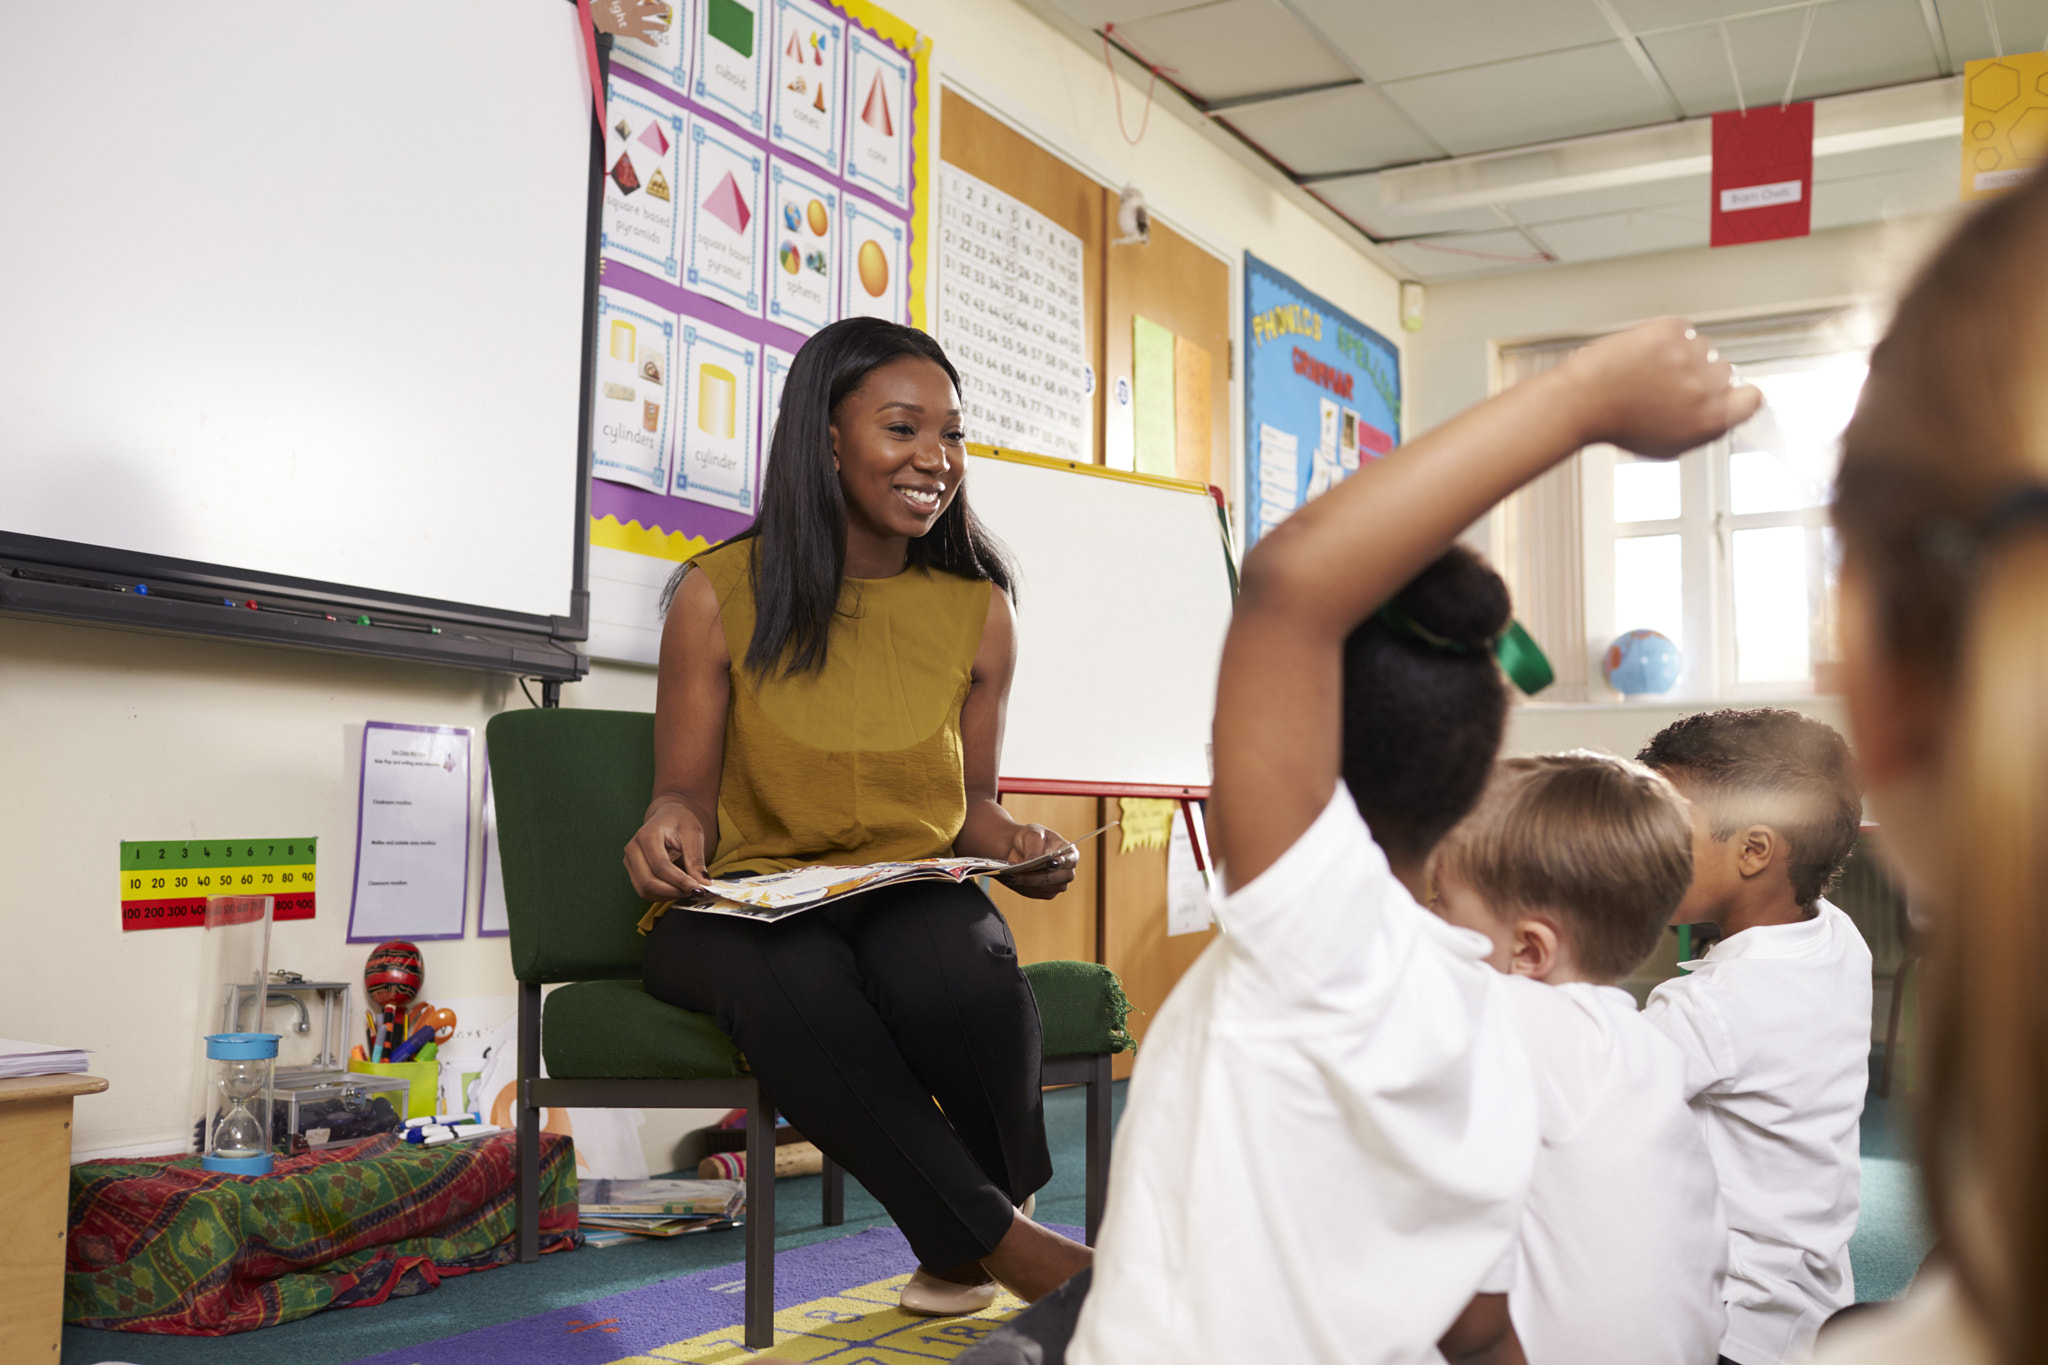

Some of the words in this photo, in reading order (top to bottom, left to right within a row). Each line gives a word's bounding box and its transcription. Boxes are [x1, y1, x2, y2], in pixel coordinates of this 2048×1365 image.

[715, 64, 747, 91] cuboid
[793, 108, 819, 129] cones
[868, 148, 887, 165] cone
[606, 196, 640, 215] square
[643, 205, 670, 229] based
[616, 220, 660, 245] pyramids
[946, 203, 957, 220] 11
[962, 210, 972, 227] 12
[976, 219, 987, 235] 13
[991, 226, 1003, 241] 14
[1006, 231, 1018, 249] 15
[1021, 241, 1032, 256] 16
[1034, 247, 1044, 261] 17
[1067, 269, 1079, 283] 20
[698, 234, 726, 253] square
[729, 244, 751, 265] based
[1068, 246, 1079, 258] 10
[708, 258, 741, 281] pyramid
[944, 228, 956, 245] 21
[960, 236, 972, 253] 22
[974, 244, 986, 260] 23
[989, 251, 1002, 267] 24
[1003, 258, 1017, 274] 25
[1018, 265, 1031, 280] 26
[1033, 271, 1045, 286] 27
[1046, 278, 1056, 294] 28
[1068, 292, 1080, 307] 30
[787, 280, 821, 304] spheres
[944, 254, 955, 271] 31
[960, 261, 971, 279] 32
[974, 268, 986, 285] 33
[1003, 282, 1015, 299] 35
[1018, 288, 1030, 305] 36
[1033, 295, 1045, 310] 37
[1047, 302, 1057, 318] 38
[1070, 316, 1081, 330] 40
[944, 282, 955, 298] 41
[960, 291, 970, 306] 42
[973, 297, 985, 312] 43
[988, 304, 1000, 318] 44
[1002, 311, 1014, 326] 45
[1016, 317, 1029, 332] 46
[1032, 323, 1044, 336] 47
[1046, 329, 1057, 344] 48
[1253, 304, 1322, 347] PHONICS
[944, 308, 955, 324] 51
[959, 315, 970, 332] 52
[973, 322, 984, 338] 53
[987, 329, 999, 344] 54
[1001, 335, 1014, 351] 55
[1016, 341, 1028, 357] 56
[1031, 347, 1043, 360] 57
[1045, 352, 1056, 368] 58
[1059, 358, 1069, 371] 59
[944, 336, 955, 352] 61
[959, 343, 970, 359] 62
[972, 350, 984, 366] 63
[986, 356, 998, 370] 64
[1001, 362, 1013, 378] 65
[1015, 368, 1027, 383] 66
[1030, 373, 1042, 388] 67
[1044, 379, 1056, 393] 68
[1058, 384, 1069, 397] 69
[1292, 346, 1354, 401] GRAMMAR
[960, 370, 970, 387] 72
[973, 376, 984, 393] 73
[986, 382, 998, 397] 74
[1001, 387, 1012, 404] 75
[1015, 393, 1027, 409] 76
[1030, 399, 1042, 413] 77
[1044, 404, 1055, 420] 78
[972, 403, 984, 420] 83
[986, 409, 998, 424] 84
[1000, 414, 1012, 430] 85
[1014, 420, 1026, 434] 86
[1029, 424, 1040, 438] 87
[602, 422, 654, 449] cylinders
[695, 448, 736, 470] cylinder
[136, 849, 140, 860] 1
[158, 848, 165, 859] 2
[181, 848, 188, 859] 3
[203, 846, 210, 857] 4
[226, 846, 232, 857] 5
[247, 846, 253, 857] 6
[268, 846, 274, 856] 7
[288, 845, 294, 856] 8
[307, 845, 314, 855] 9
[130, 878, 141, 889] 10
[151, 878, 165, 889] 20
[175, 877, 188, 888] 30
[197, 876, 210, 886] 40
[219, 875, 232, 886] 50
[241, 874, 253, 885] 60
[262, 873, 274, 884] 70
[282, 872, 294, 883] 80
[302, 872, 314, 882] 90
[123, 908, 141, 919] 100
[144, 906, 164, 919] 200
[167, 905, 187, 917] 300
[190, 905, 209, 916] 400
[276, 900, 293, 911] 800
[296, 899, 314, 910] 900
